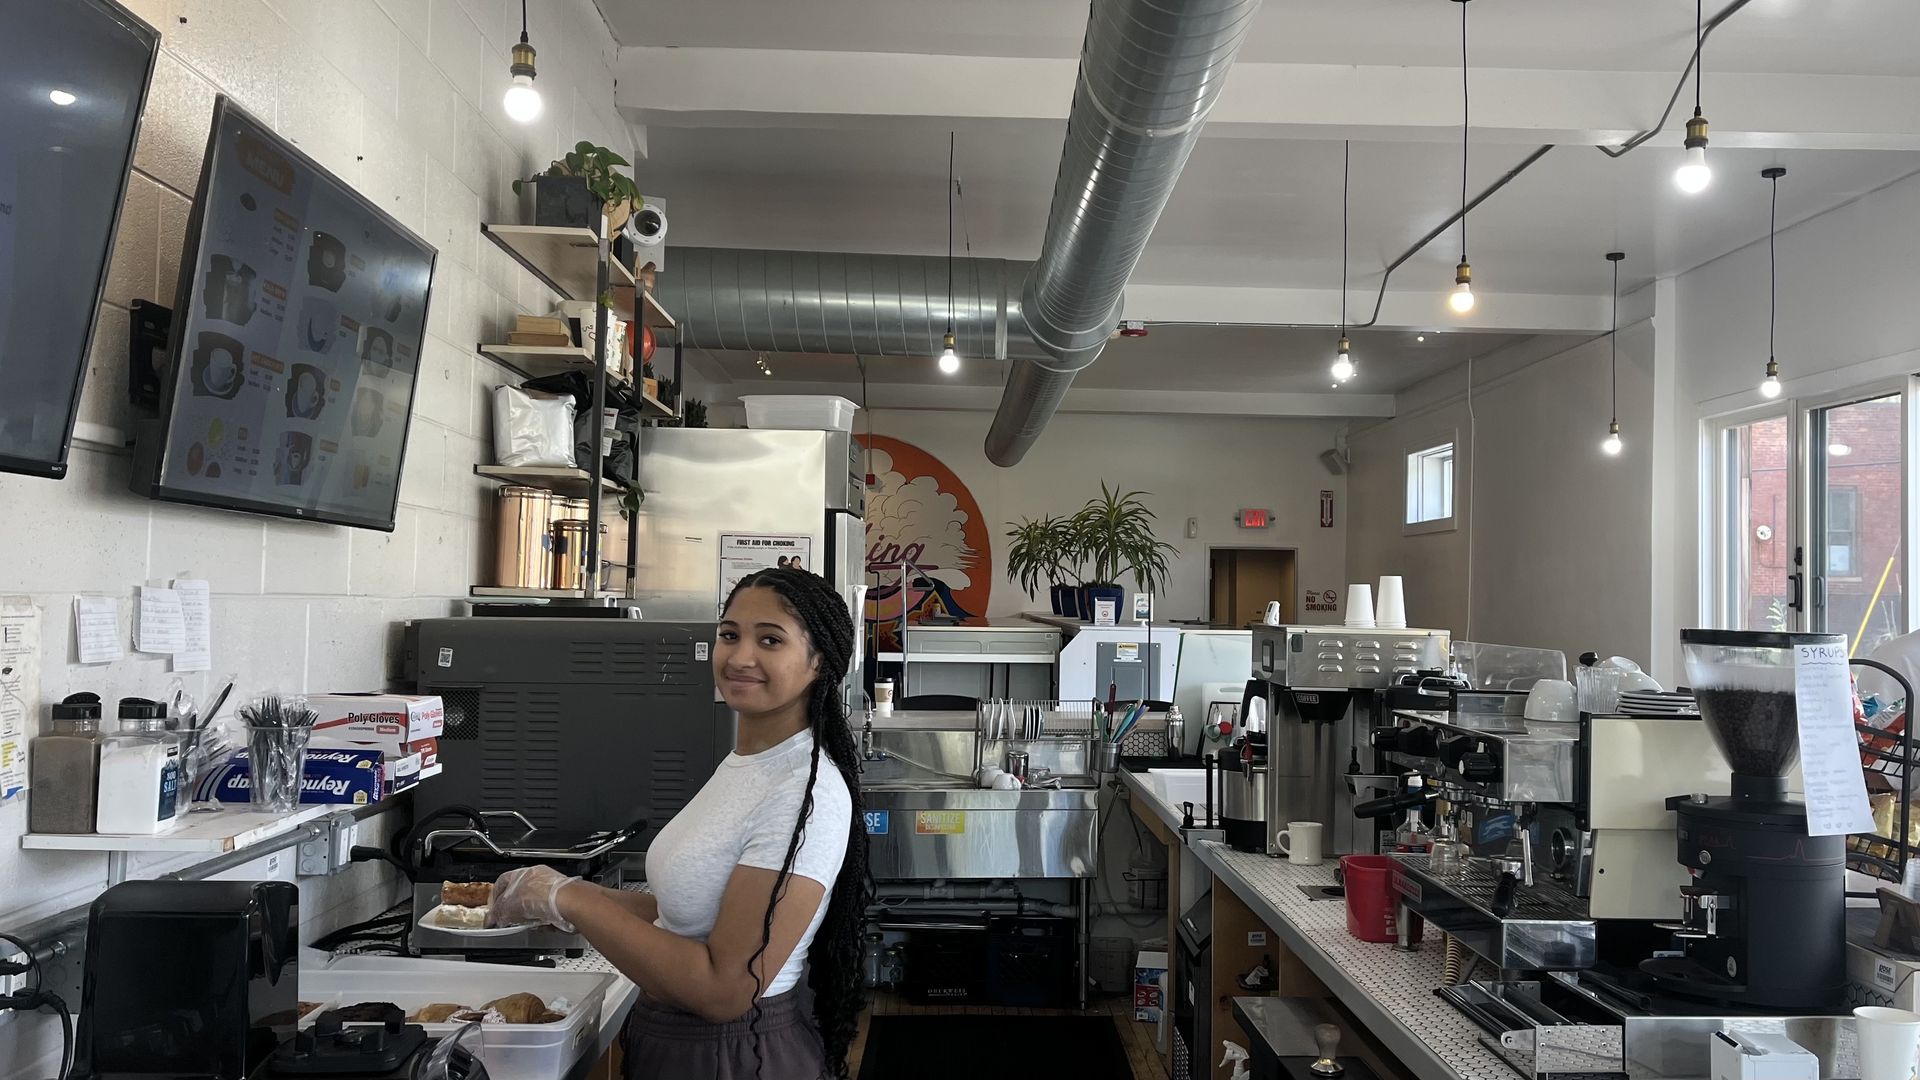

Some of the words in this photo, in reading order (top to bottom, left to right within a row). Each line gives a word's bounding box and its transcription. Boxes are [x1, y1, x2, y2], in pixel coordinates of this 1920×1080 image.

[1245, 510, 1265, 527] EXIT
[1305, 595, 1316, 603] NO
[1305, 603, 1337, 612] SMOKING
[1801, 646, 1845, 660] SYRUPS
[348, 712, 367, 725] Poly
[368, 713, 400, 724] Gloves
[305, 752, 358, 763] Reyno
[301, 776, 350, 796] Reyno
[920, 812, 961, 824] SANITIZE
